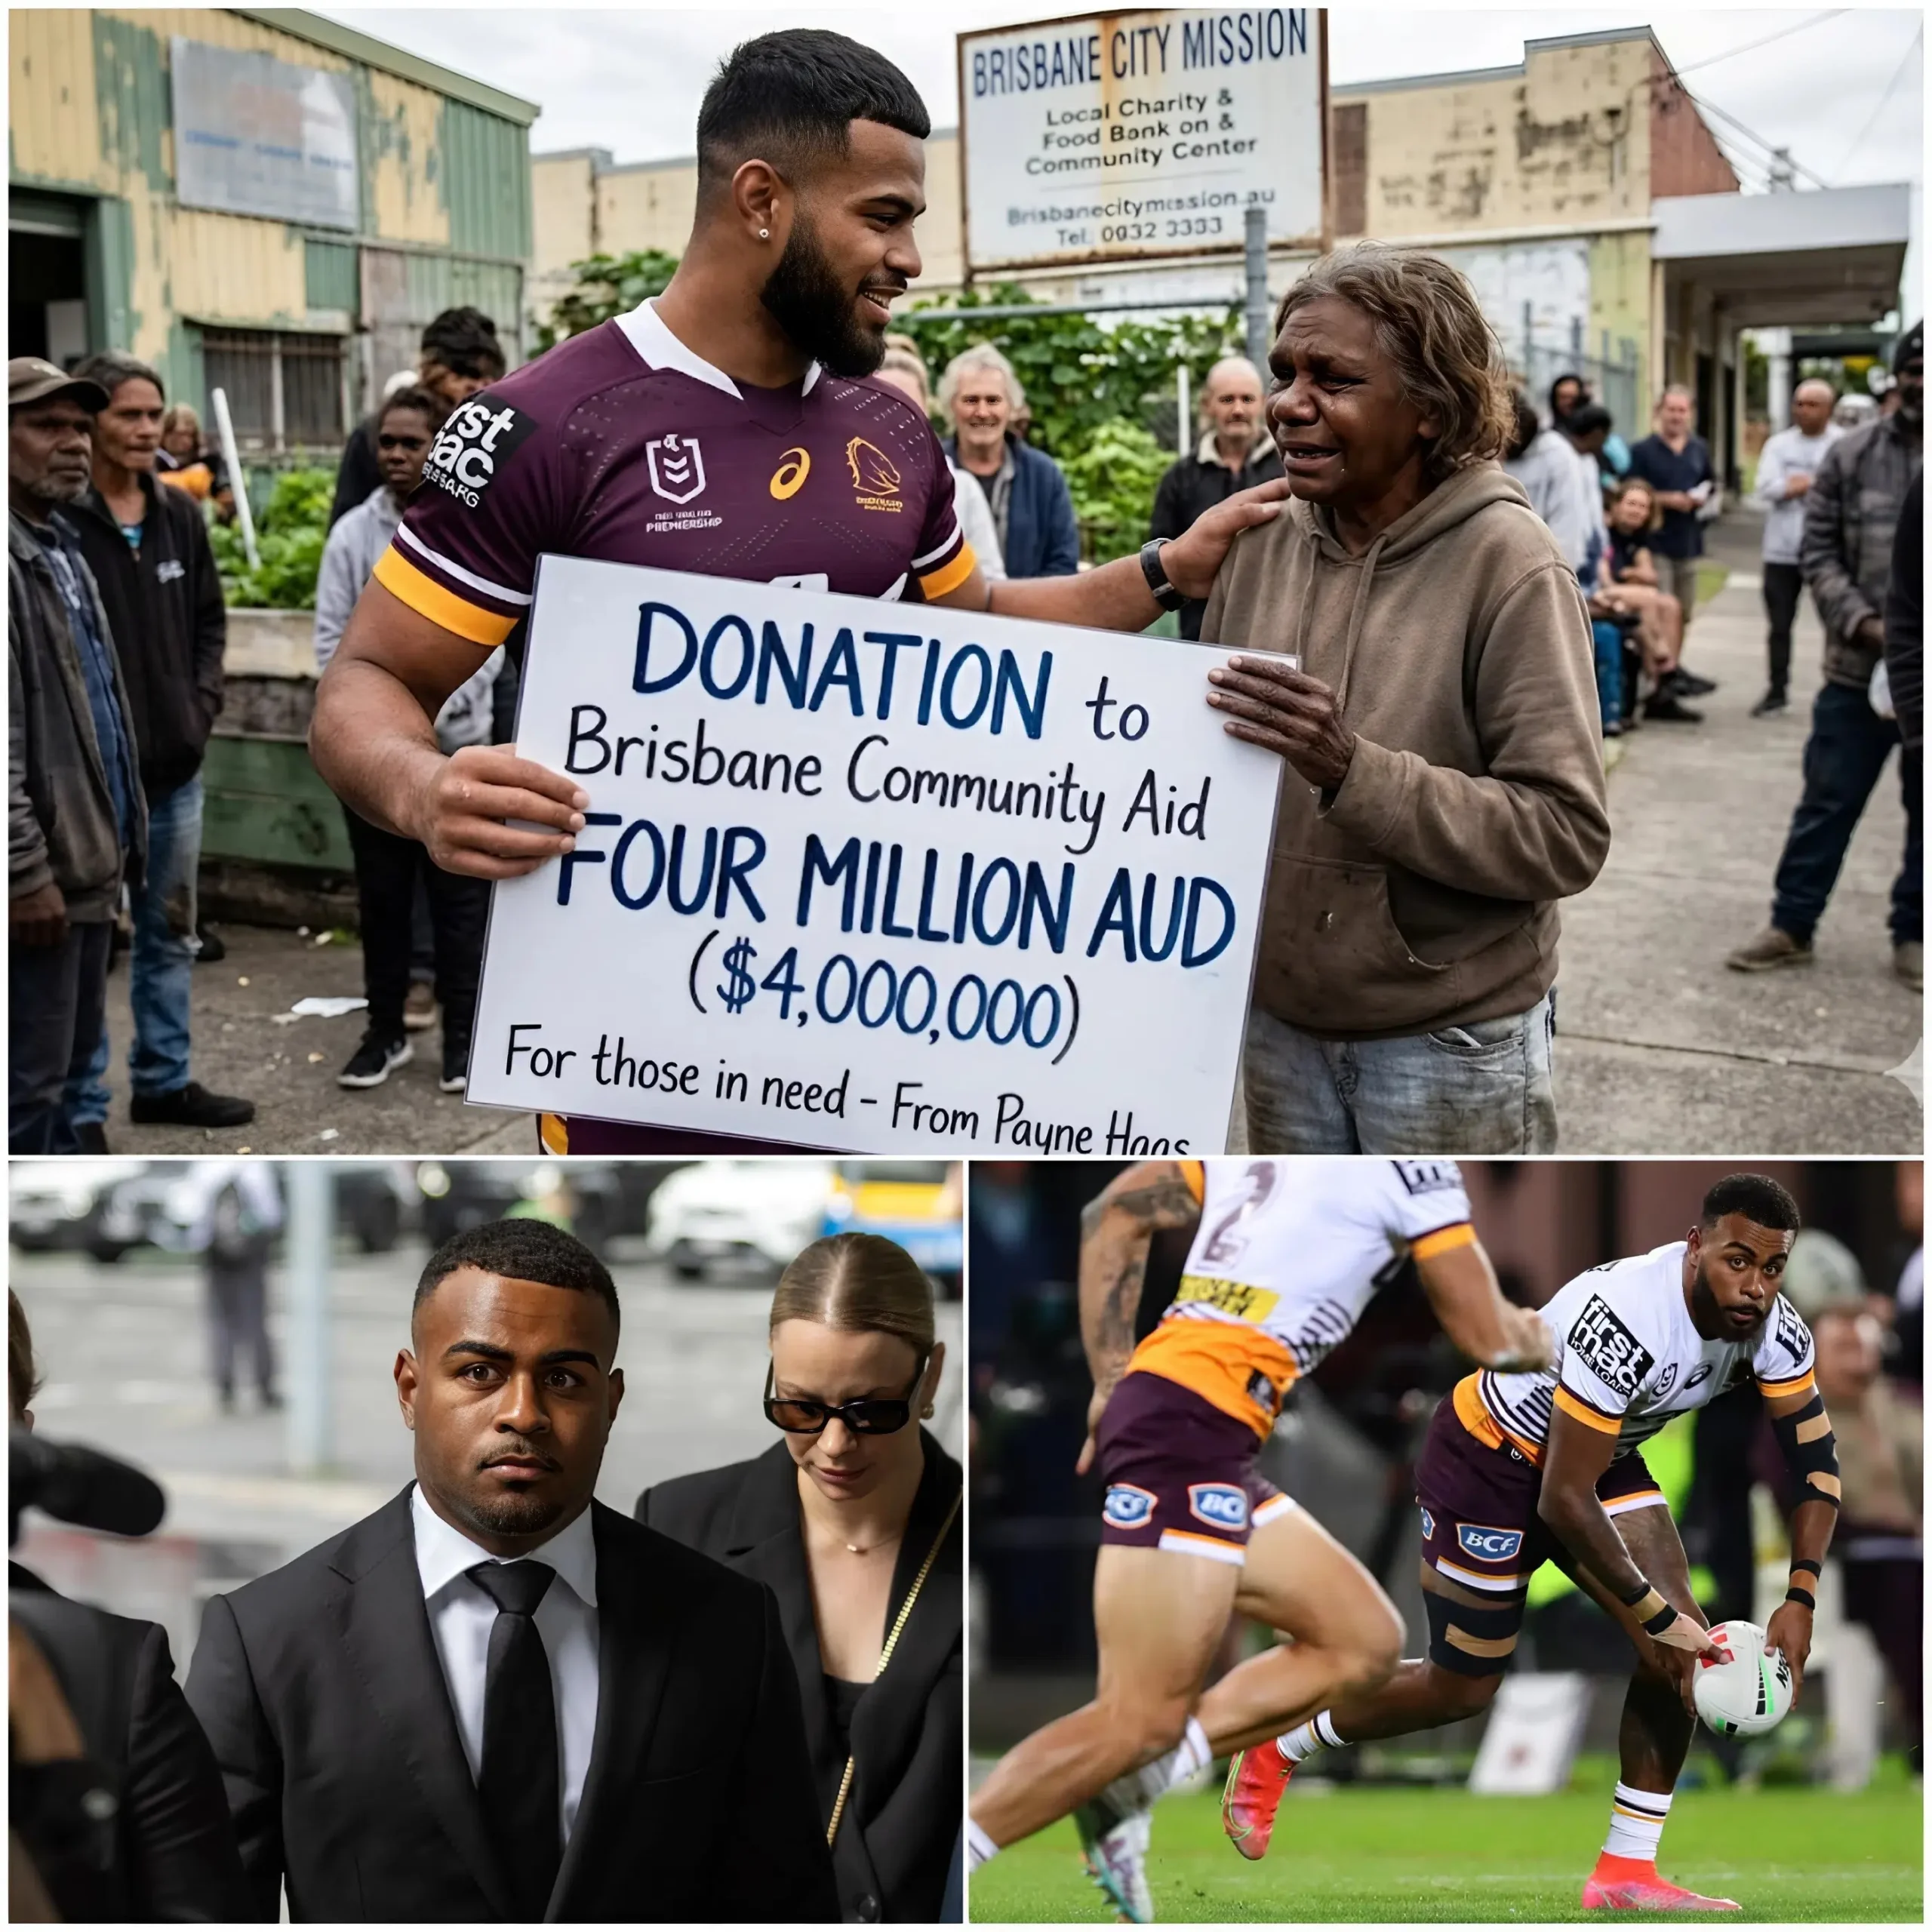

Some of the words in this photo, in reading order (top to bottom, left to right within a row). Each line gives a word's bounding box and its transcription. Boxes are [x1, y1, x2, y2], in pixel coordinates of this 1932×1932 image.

[974, 35, 1101, 97] BRISBANE
[1112, 24, 1171, 78] CITY
[1183, 8, 1306, 70] MISSION
[1042, 129, 1100, 149] Food
[1180, 118, 1208, 134] on
[1219, 113, 1235, 131] &
[1046, 103, 1110, 126] Local
[1119, 94, 1207, 116] Charity
[1217, 88, 1233, 106] &
[1025, 147, 1162, 175] Community
[1172, 137, 1258, 160] Center
[632, 602, 1053, 739] DONATION
[1085, 676, 1149, 741] to
[565, 704, 822, 795] Brisbane
[848, 734, 1105, 854] Community
[1122, 768, 1211, 840] Aid
[557, 813, 766, 923] FOUR
[797, 833, 1075, 954] MILLION
[1087, 868, 1235, 968] AUD
[689, 930, 1079, 1065] ($4,000,000)
[506, 1024, 576, 1078] For
[592, 1034, 699, 1095] those
[715, 1059, 747, 1102] in
[762, 1069, 850, 1118] need
[892, 1082, 978, 1140] From
[995, 1094, 1092, 1155] Payne
[1574, 1318, 1638, 1389] mac
[1583, 1299, 1644, 1372] first
[1466, 1531, 1515, 1553] BCF
